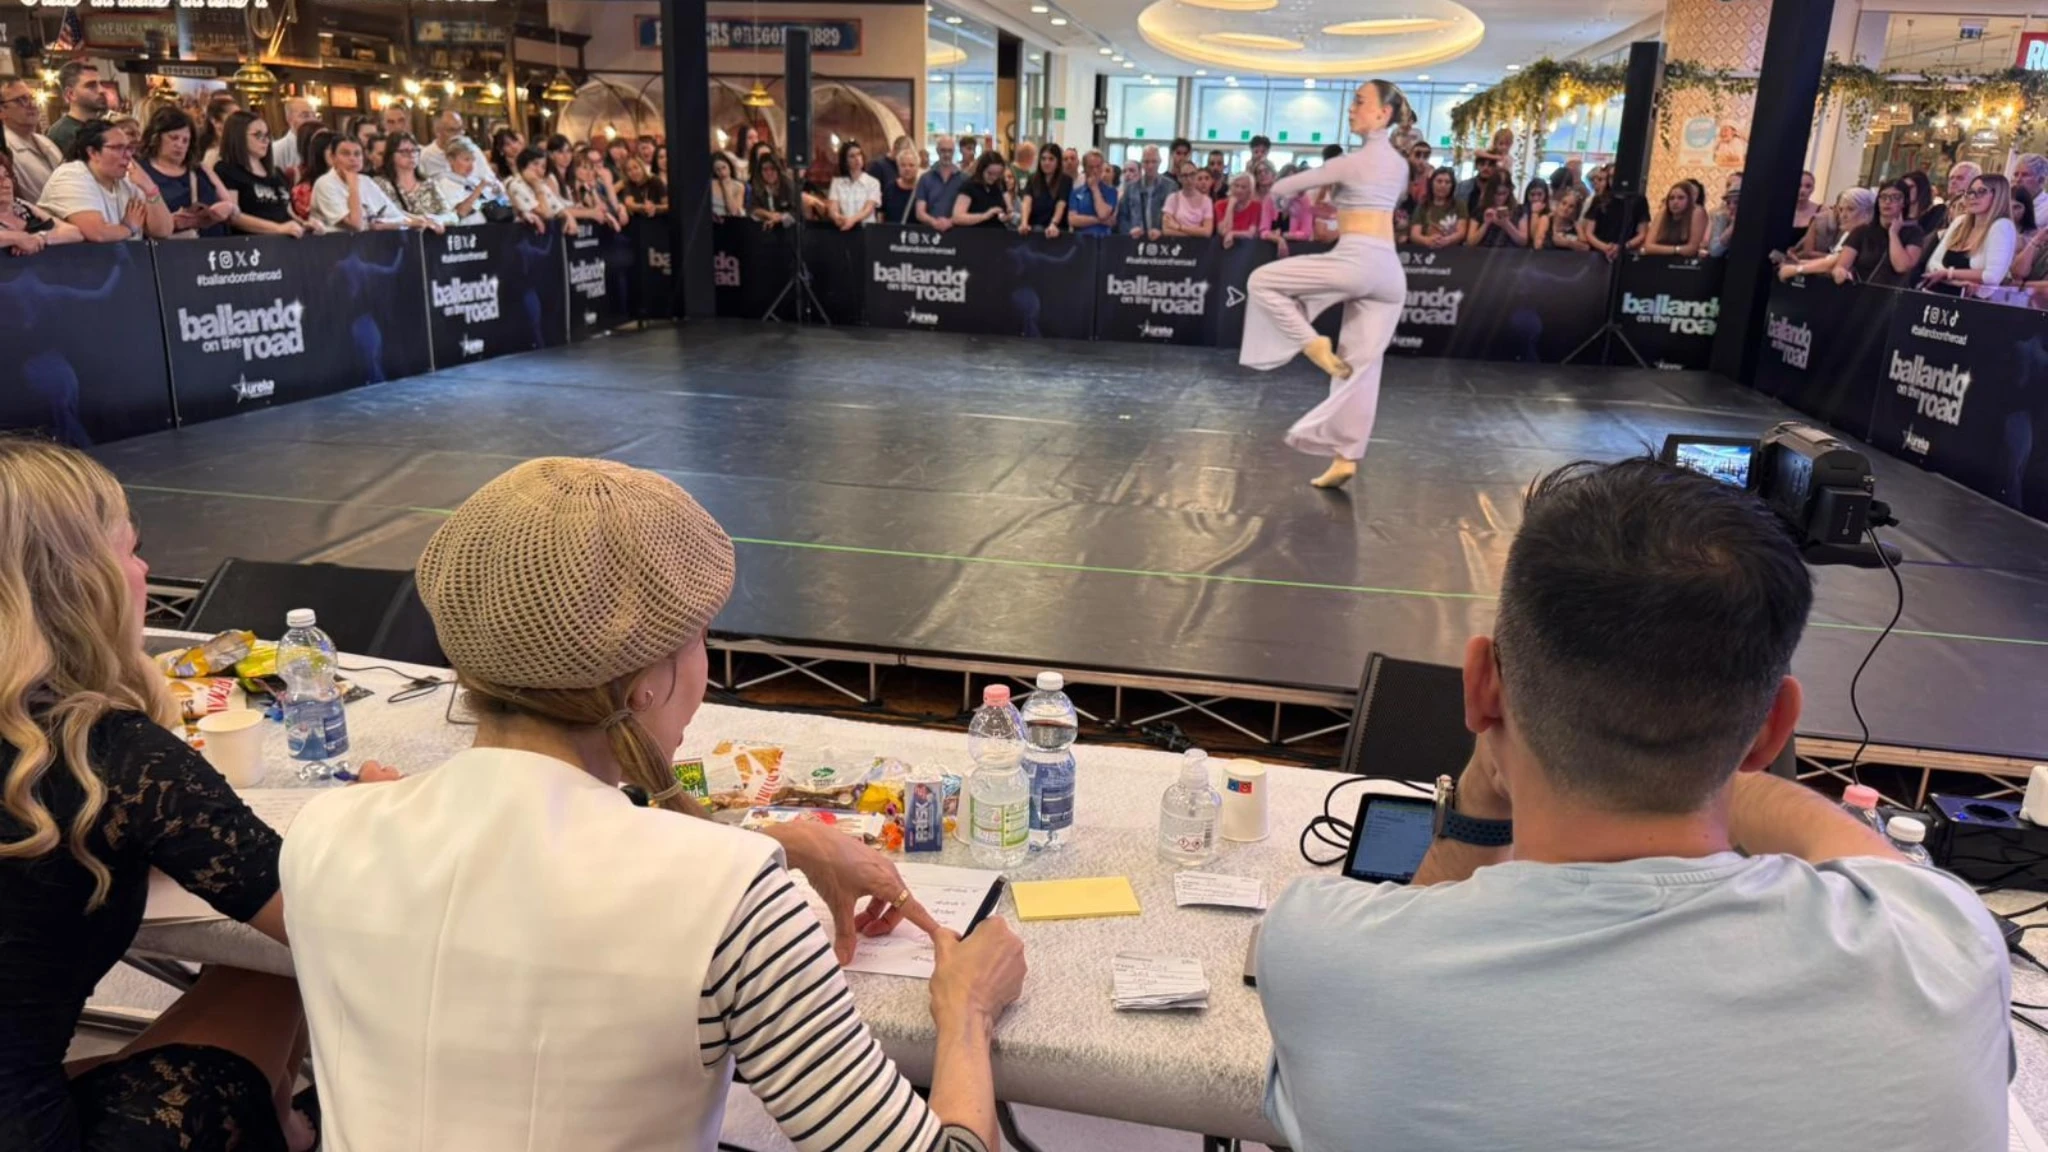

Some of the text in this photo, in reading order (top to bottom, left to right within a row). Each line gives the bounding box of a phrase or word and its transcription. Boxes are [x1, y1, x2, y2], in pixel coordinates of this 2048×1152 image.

[873, 261, 968, 287] ballando
[1107, 273, 1208, 298] ballando
[432, 273, 499, 308] ballando
[916, 283, 966, 303] road
[465, 300, 500, 324] road
[1151, 296, 1205, 315] road
[1400, 306, 1458, 325] road
[1622, 292, 1719, 319] balland
[178, 298, 302, 342] ballando
[1670, 318, 1717, 335] roa
[202, 327, 304, 361] on the road
[1889, 349, 1971, 398] ballando
[1917, 391, 1965, 426] road
